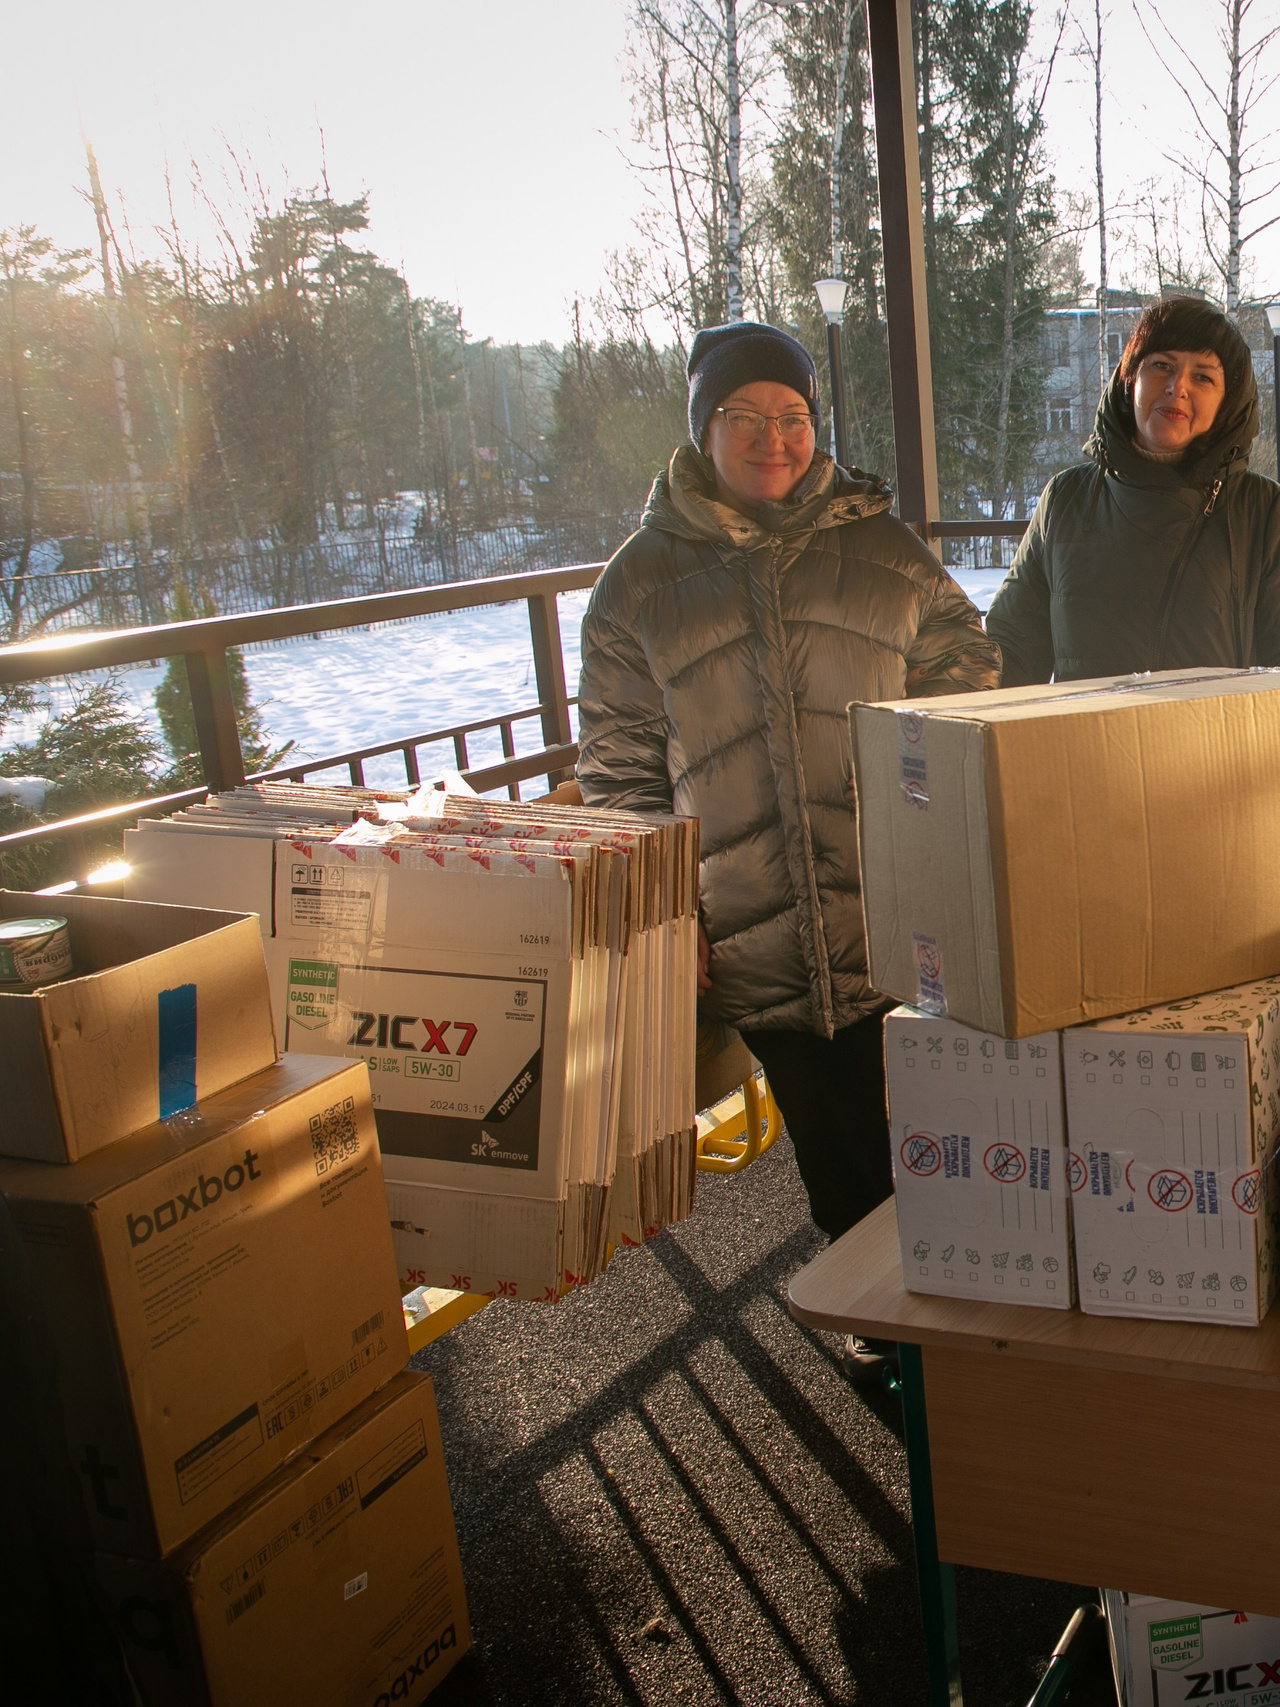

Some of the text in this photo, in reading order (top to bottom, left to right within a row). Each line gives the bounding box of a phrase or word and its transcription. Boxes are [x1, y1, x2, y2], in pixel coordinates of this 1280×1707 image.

[553, 842, 573, 856] SK
[519, 934, 550, 946] 162619
[292, 968, 336, 980] SYNTHETIC
[518, 966, 549, 978] 162619
[290, 991, 335, 1006] GASOLINE
[296, 1004, 328, 1019] DIESEL
[347, 1010, 478, 1057] ZIC X7
[382, 1057, 399, 1066] LOW
[382, 1064, 401, 1074] SAPS
[411, 1061, 454, 1079] 5W-30
[497, 1070, 535, 1117] DPF/CPF
[429, 1099, 486, 1115] 2024.03.15
[470, 1143, 530, 1163] SK enmove
[126, 1148, 261, 1248] boxbot
[406, 1268, 426, 1285] SK
[450, 1273, 471, 1290] SK
[497, 1280, 518, 1297] SK
[1152, 1621, 1199, 1637] SYNTHETIC
[1152, 1638, 1200, 1655] GASOLINE
[1160, 1650, 1194, 1665] DIESEL
[1183, 1662, 1254, 1701] ZIC
